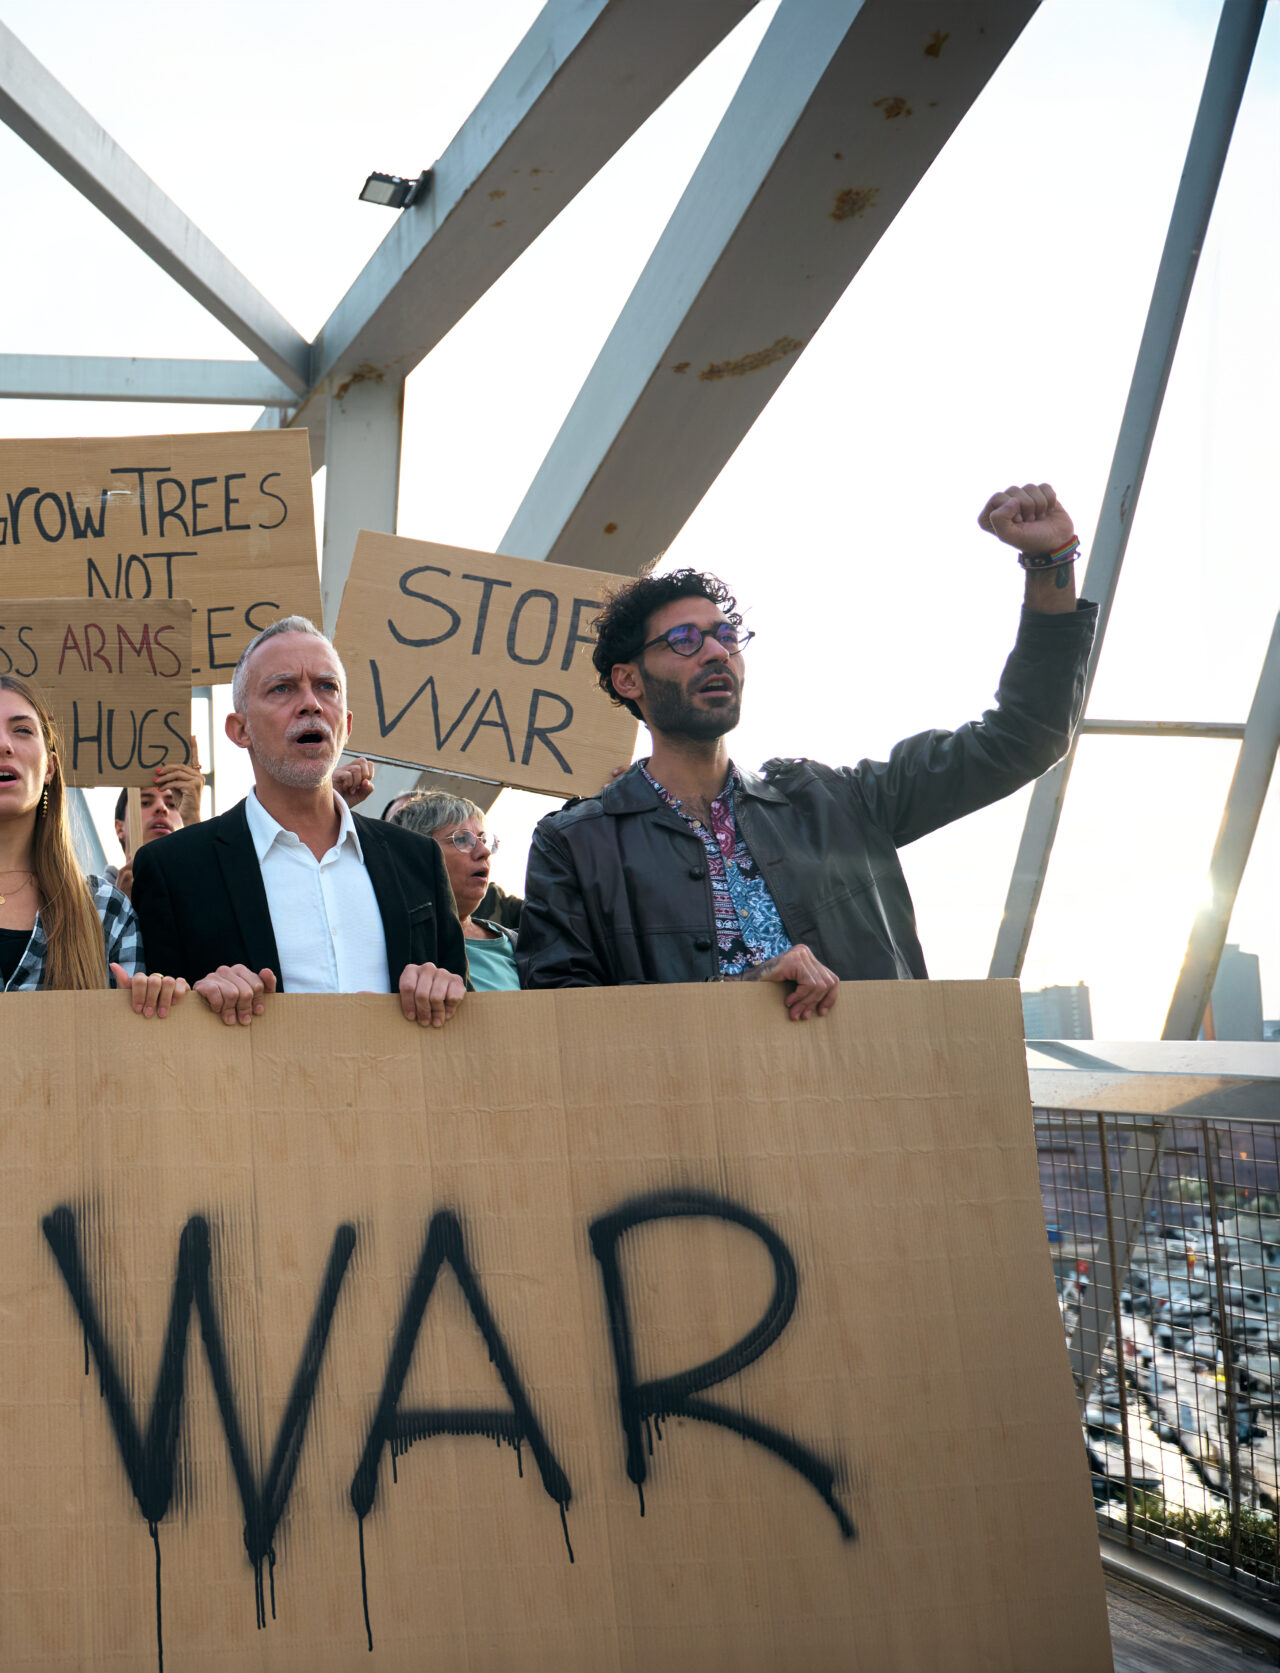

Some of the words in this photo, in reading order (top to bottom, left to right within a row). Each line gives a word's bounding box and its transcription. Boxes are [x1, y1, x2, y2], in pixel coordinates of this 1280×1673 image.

[110, 467, 288, 538] TREES
[87, 551, 198, 600] NOT
[58, 623, 182, 678] ARMS
[72, 700, 191, 775] HUGS
[369, 659, 573, 775] WAR
[41, 1190, 858, 1582] WAR
